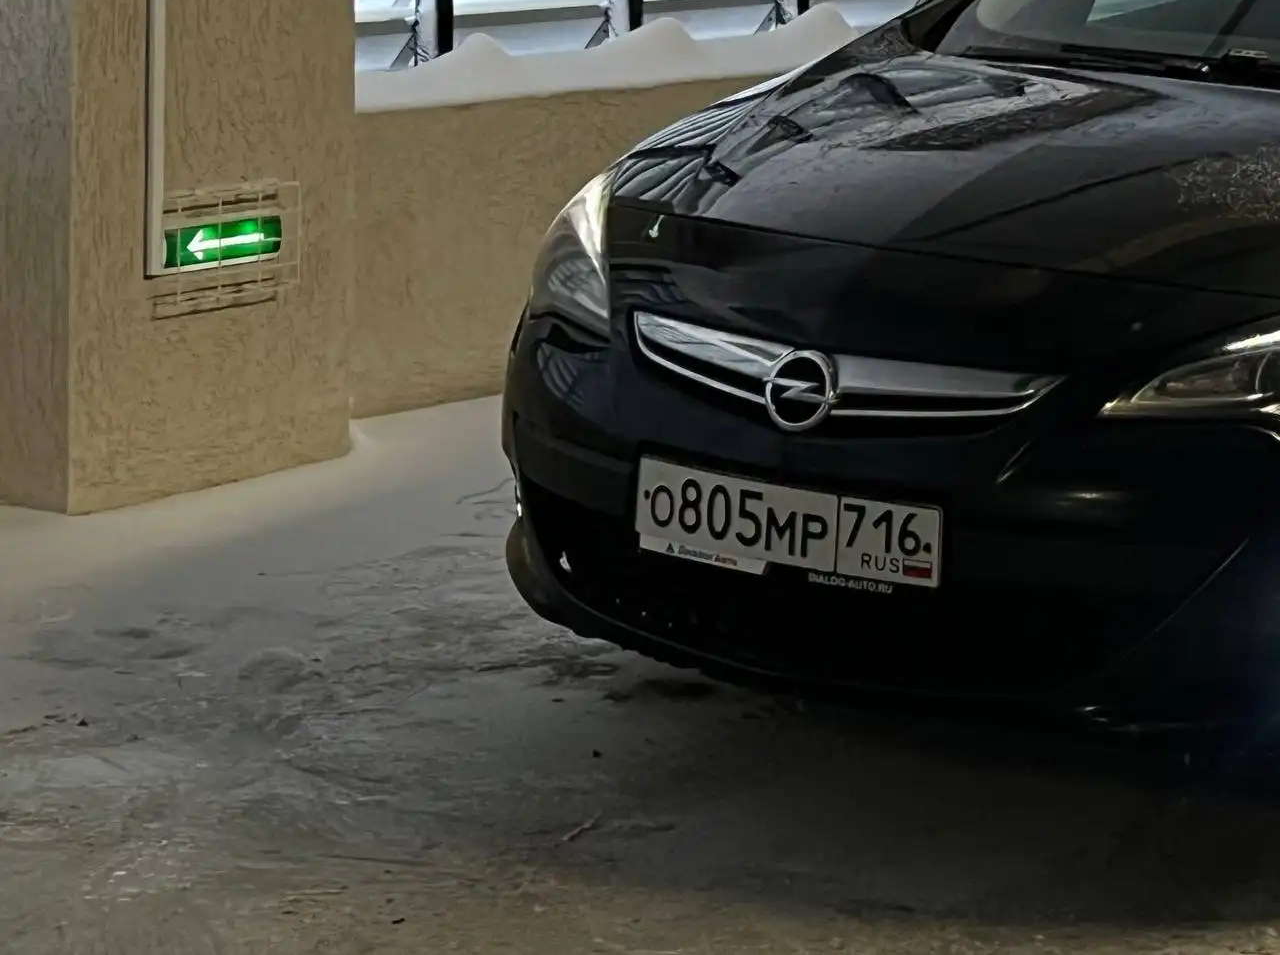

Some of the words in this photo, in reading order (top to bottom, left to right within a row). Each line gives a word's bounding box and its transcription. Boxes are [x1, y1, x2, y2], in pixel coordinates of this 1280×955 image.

[843, 503, 923, 557] 716
[860, 552, 900, 573] RUS
[807, 572, 893, 594] DIALOG-AUTO.RU
